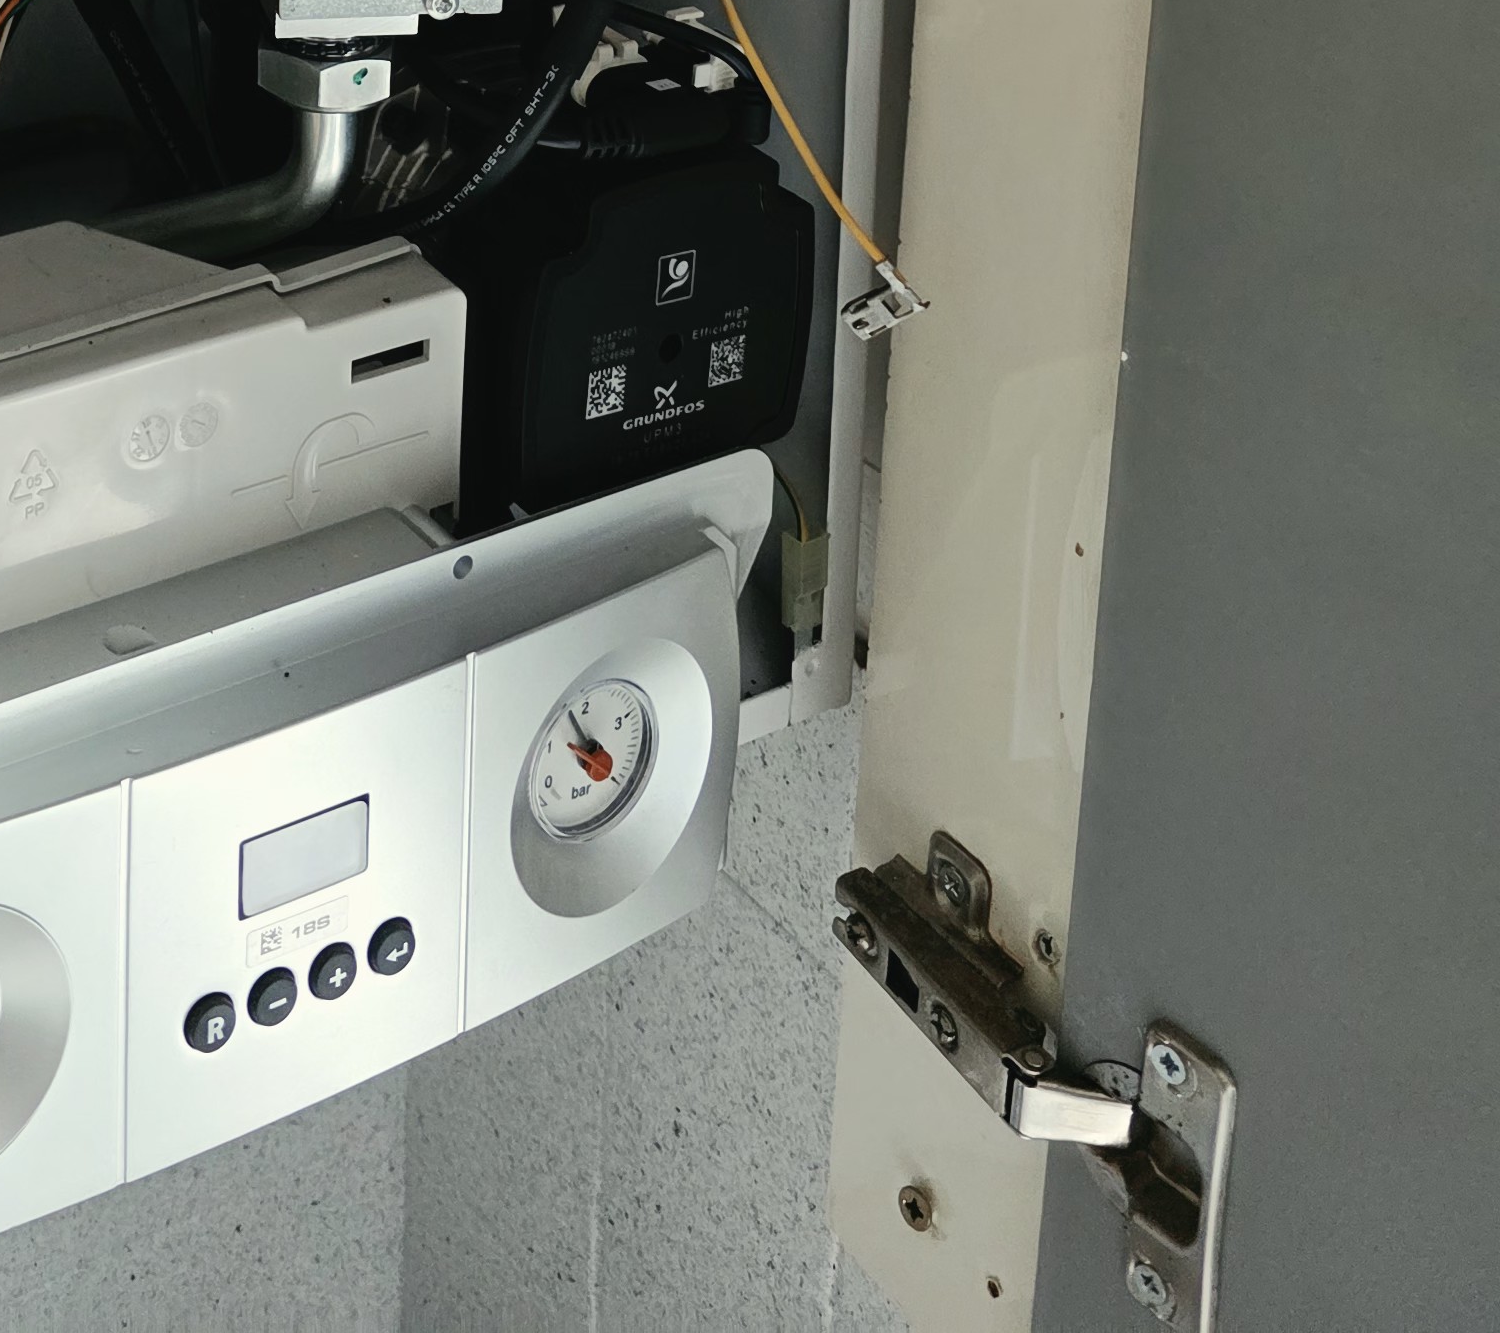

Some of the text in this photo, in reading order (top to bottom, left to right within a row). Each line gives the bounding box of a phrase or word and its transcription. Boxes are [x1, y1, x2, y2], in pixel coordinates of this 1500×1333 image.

[454, 181, 476, 202] TYPE
[724, 306, 750, 319] High
[691, 319, 748, 340] Efficiency
[622, 399, 705, 430] GRUNDFOS
[25, 472, 43, 488] 05
[25, 501, 45, 519] PP
[581, 701, 590, 715] 2
[614, 716, 622, 730] 3
[547, 740, 552, 754] 1
[544, 775, 553, 788] 0
[571, 783, 592, 799] bar
[291, 914, 331, 939] 18S
[207, 1016, 225, 1044] R
